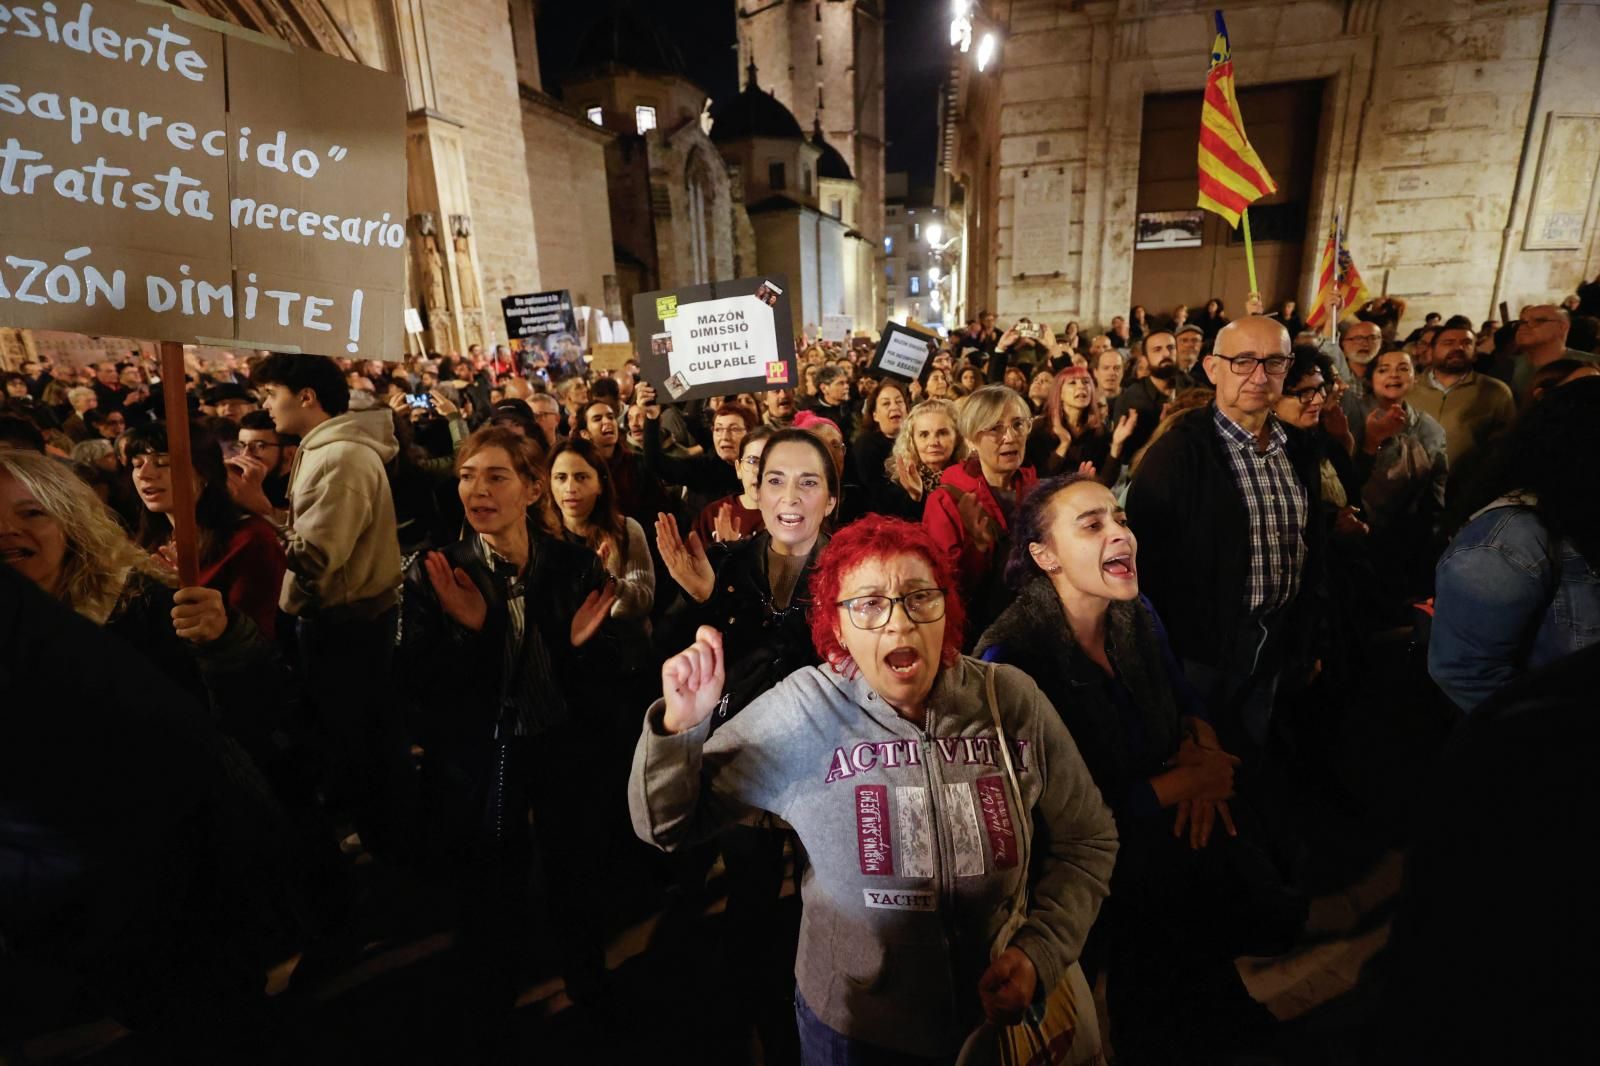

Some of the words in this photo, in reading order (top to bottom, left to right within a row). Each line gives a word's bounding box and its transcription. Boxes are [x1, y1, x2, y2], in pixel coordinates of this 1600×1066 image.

[0, 137, 214, 220] tratista
[230, 196, 405, 248] necesario
[697, 310, 745, 325] MAZÓN
[690, 321, 749, 338] DIMISSIÓ
[697, 340, 741, 355] INÚTIL
[689, 355, 757, 372] CULPABLE
[769, 362, 785, 377] PP
[860, 790, 876, 813] REMO
[861, 816, 877, 834] SAN
[868, 893, 932, 906] YACHT
